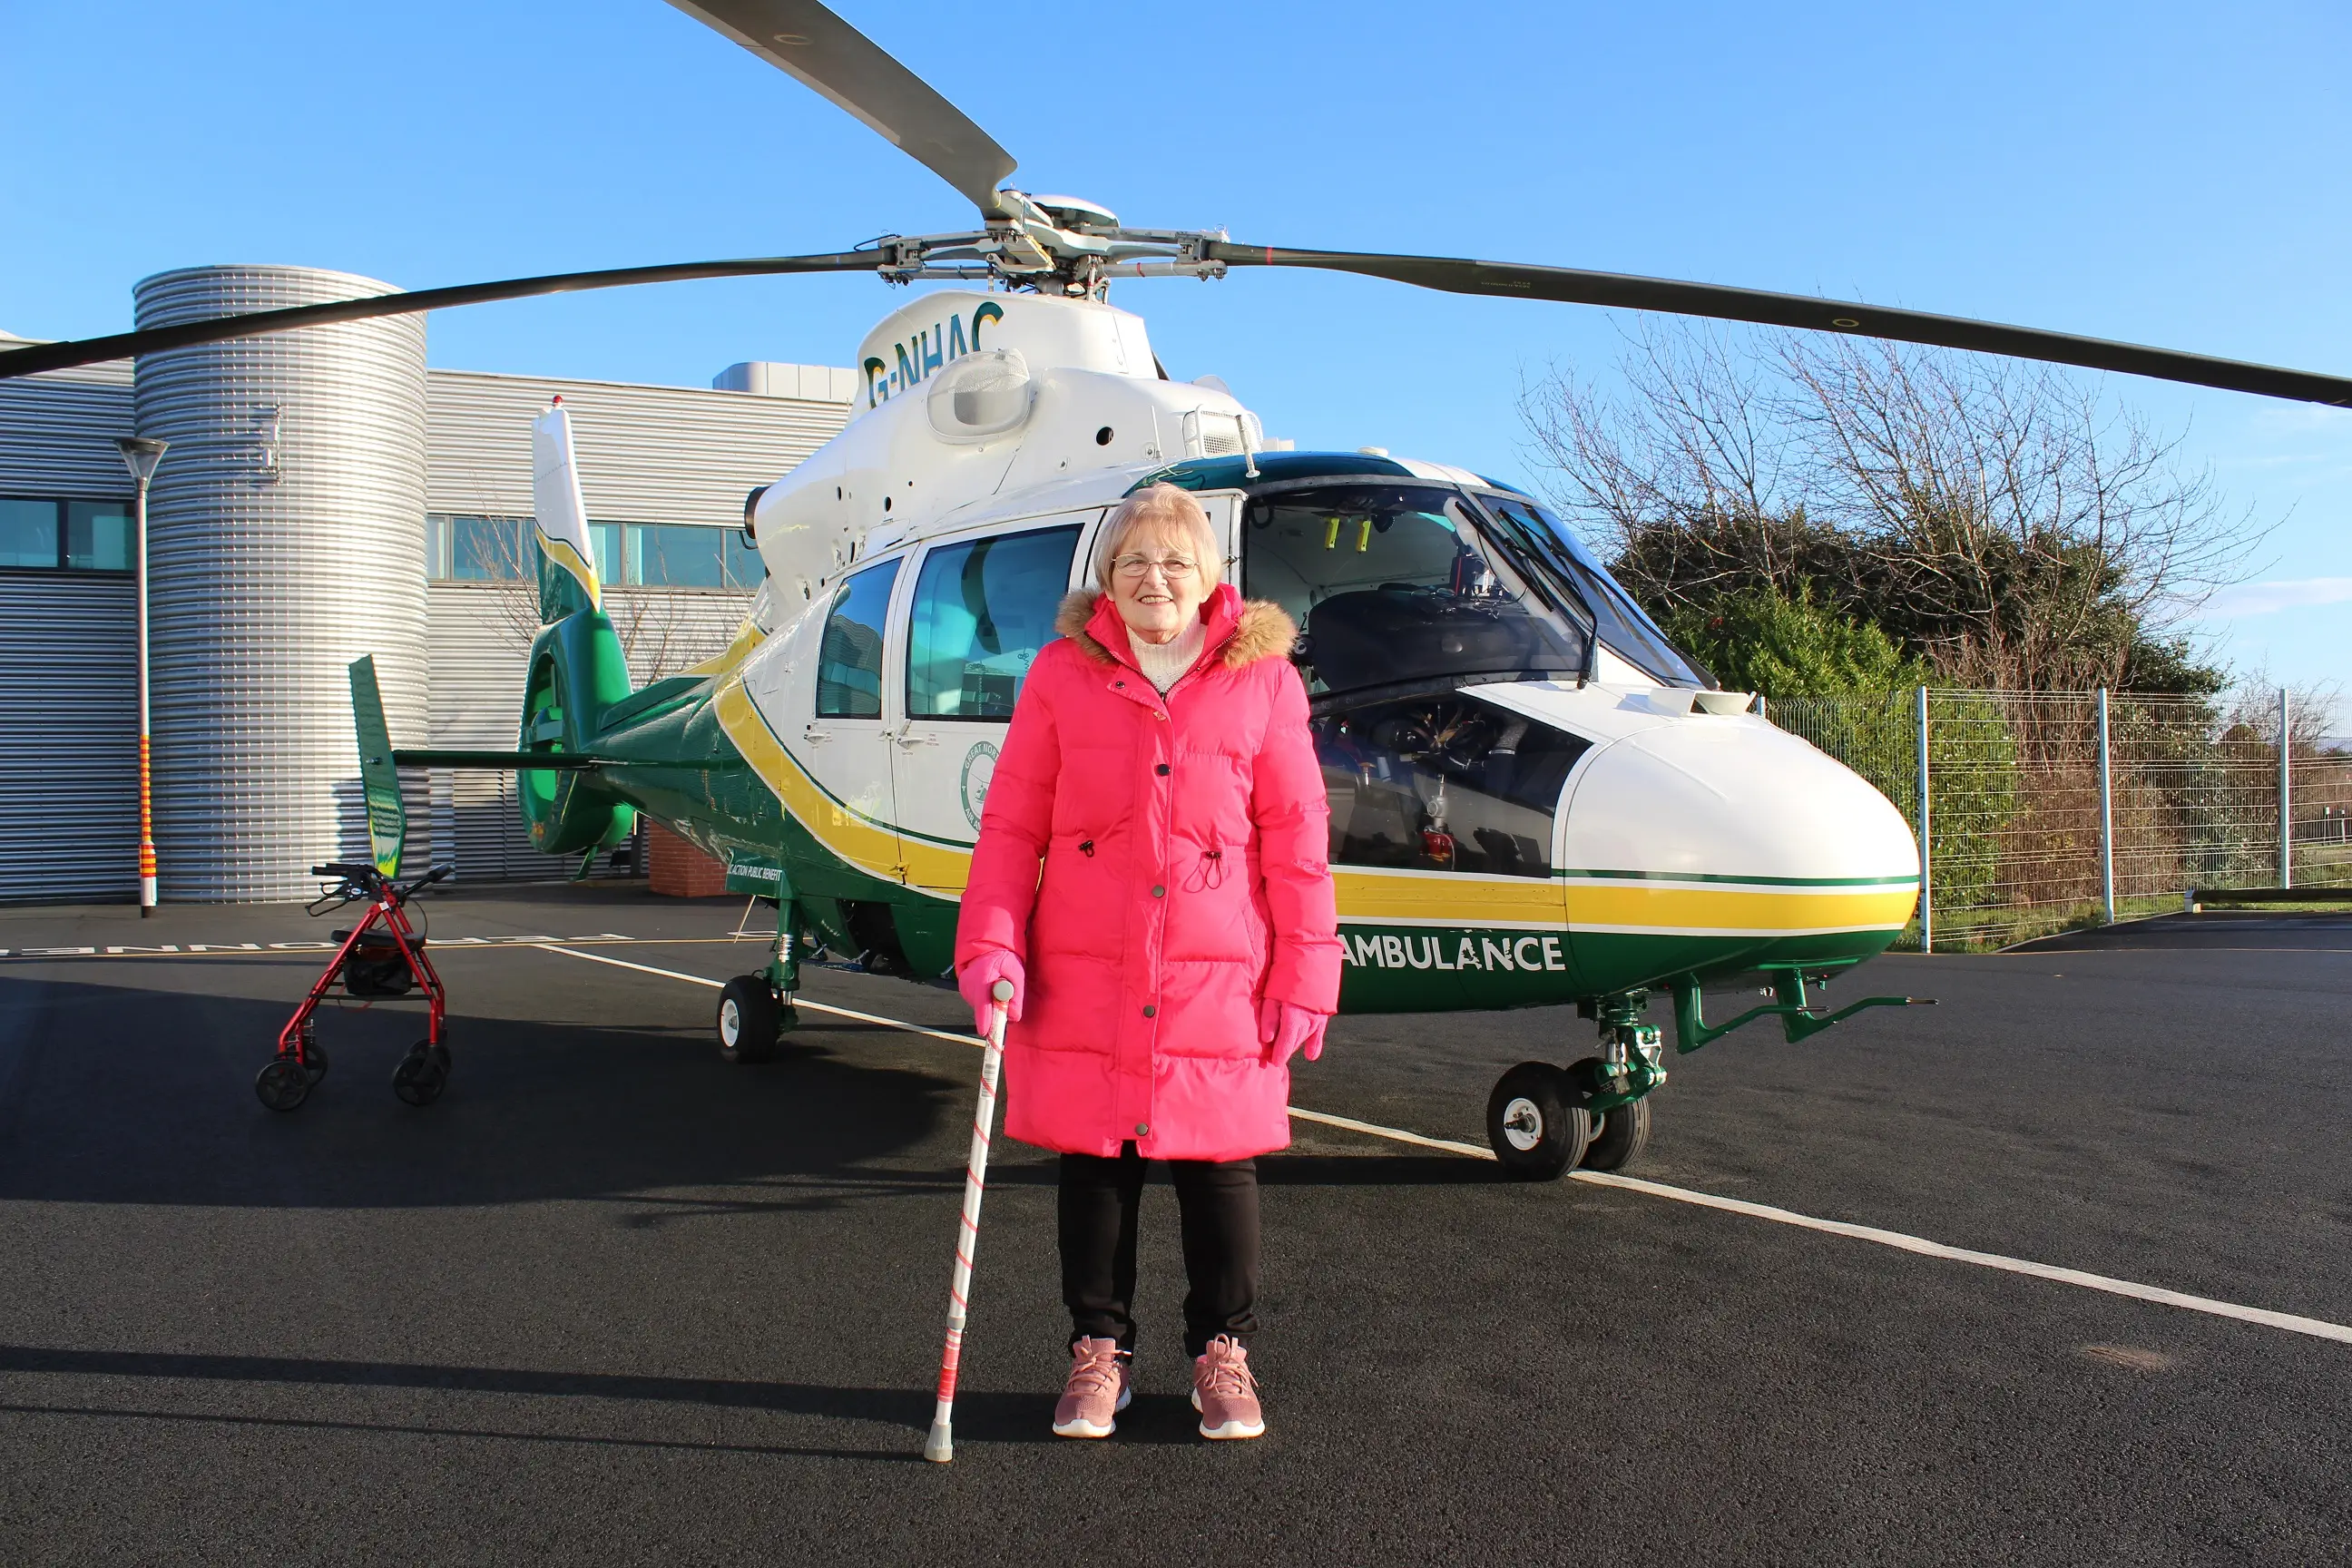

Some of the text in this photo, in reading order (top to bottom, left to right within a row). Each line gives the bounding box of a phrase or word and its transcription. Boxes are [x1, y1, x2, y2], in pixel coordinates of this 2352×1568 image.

[863, 300, 1004, 409] G-NHAC
[965, 744, 982, 769] GREAT
[731, 864, 750, 877] ACTION
[748, 865, 764, 879] PUBLIC
[762, 867, 783, 882] BENEFIT
[1336, 933, 1567, 972] AMBULANCE
